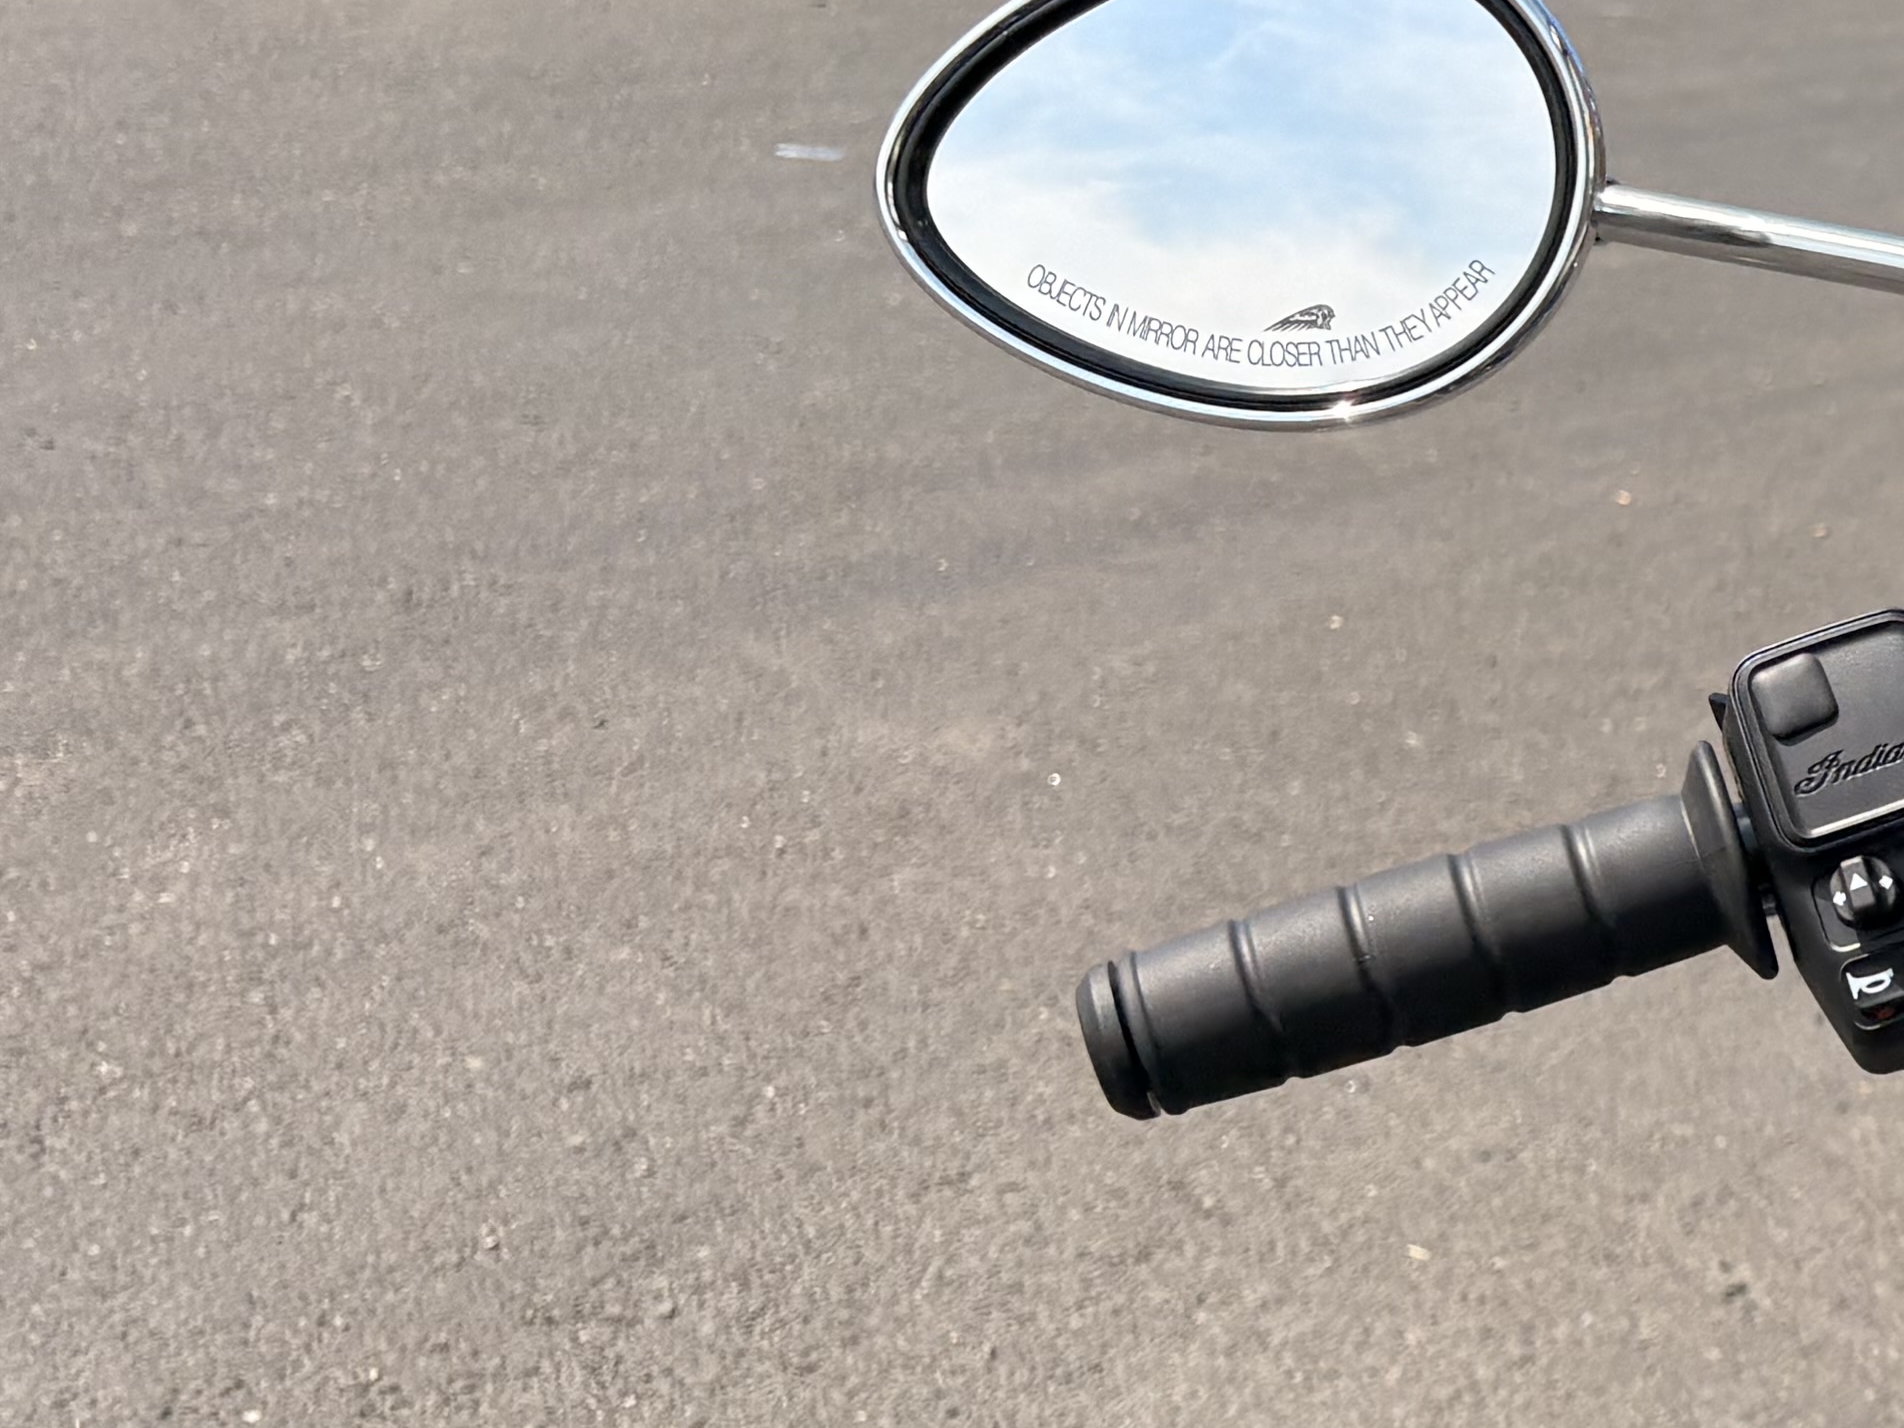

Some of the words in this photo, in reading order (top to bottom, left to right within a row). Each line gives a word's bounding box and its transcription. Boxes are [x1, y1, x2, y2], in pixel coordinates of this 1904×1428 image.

[1027, 264, 1106, 320] OBJECTS
[1106, 303, 1128, 332] IN
[1127, 313, 1200, 356] MIRROR
[1201, 338, 1242, 365] ARE
[1247, 340, 1322, 367] CLOSER
[1326, 331, 1381, 365] THAN
[1380, 305, 1434, 353] THEY
[1431, 258, 1497, 334] APPEAR
